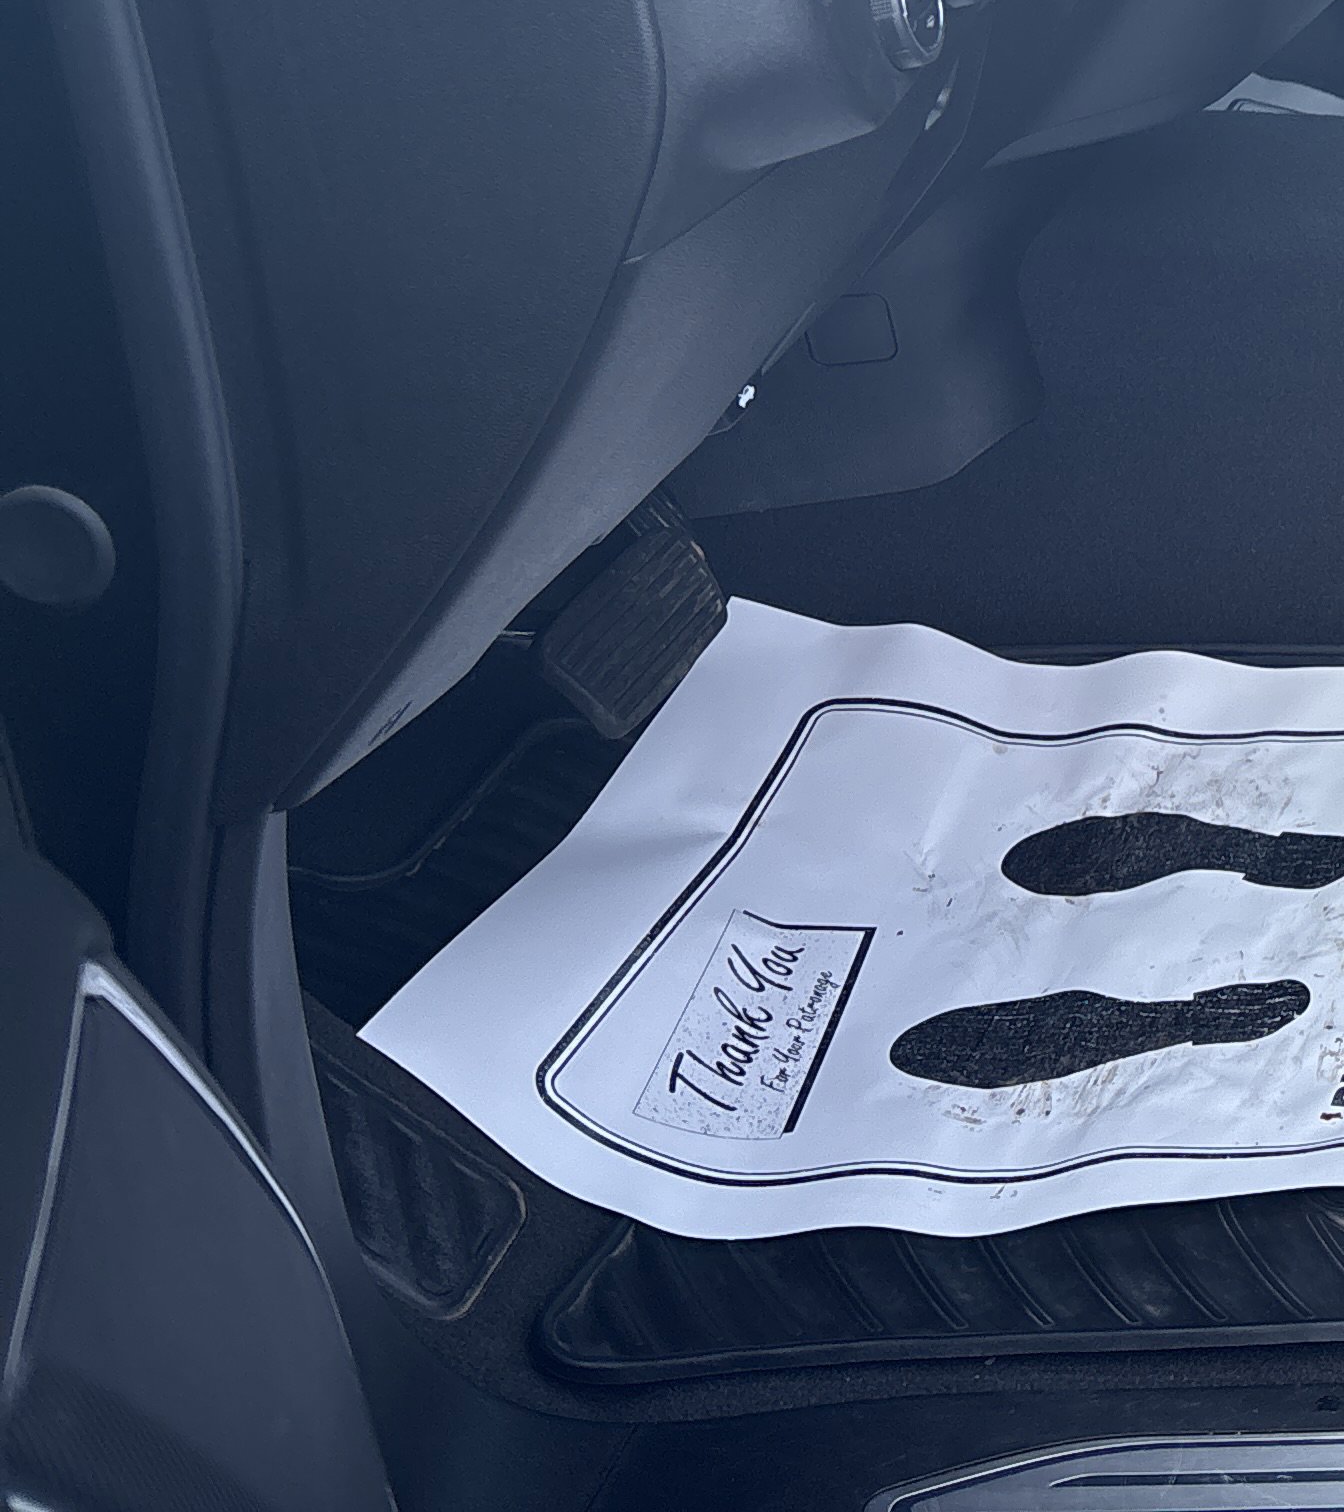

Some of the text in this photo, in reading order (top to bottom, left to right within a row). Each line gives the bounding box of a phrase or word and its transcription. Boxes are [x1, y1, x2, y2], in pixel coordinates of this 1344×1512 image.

[669, 944, 806, 1112] Thank You
[760, 970, 841, 1093] For Your Patronage
